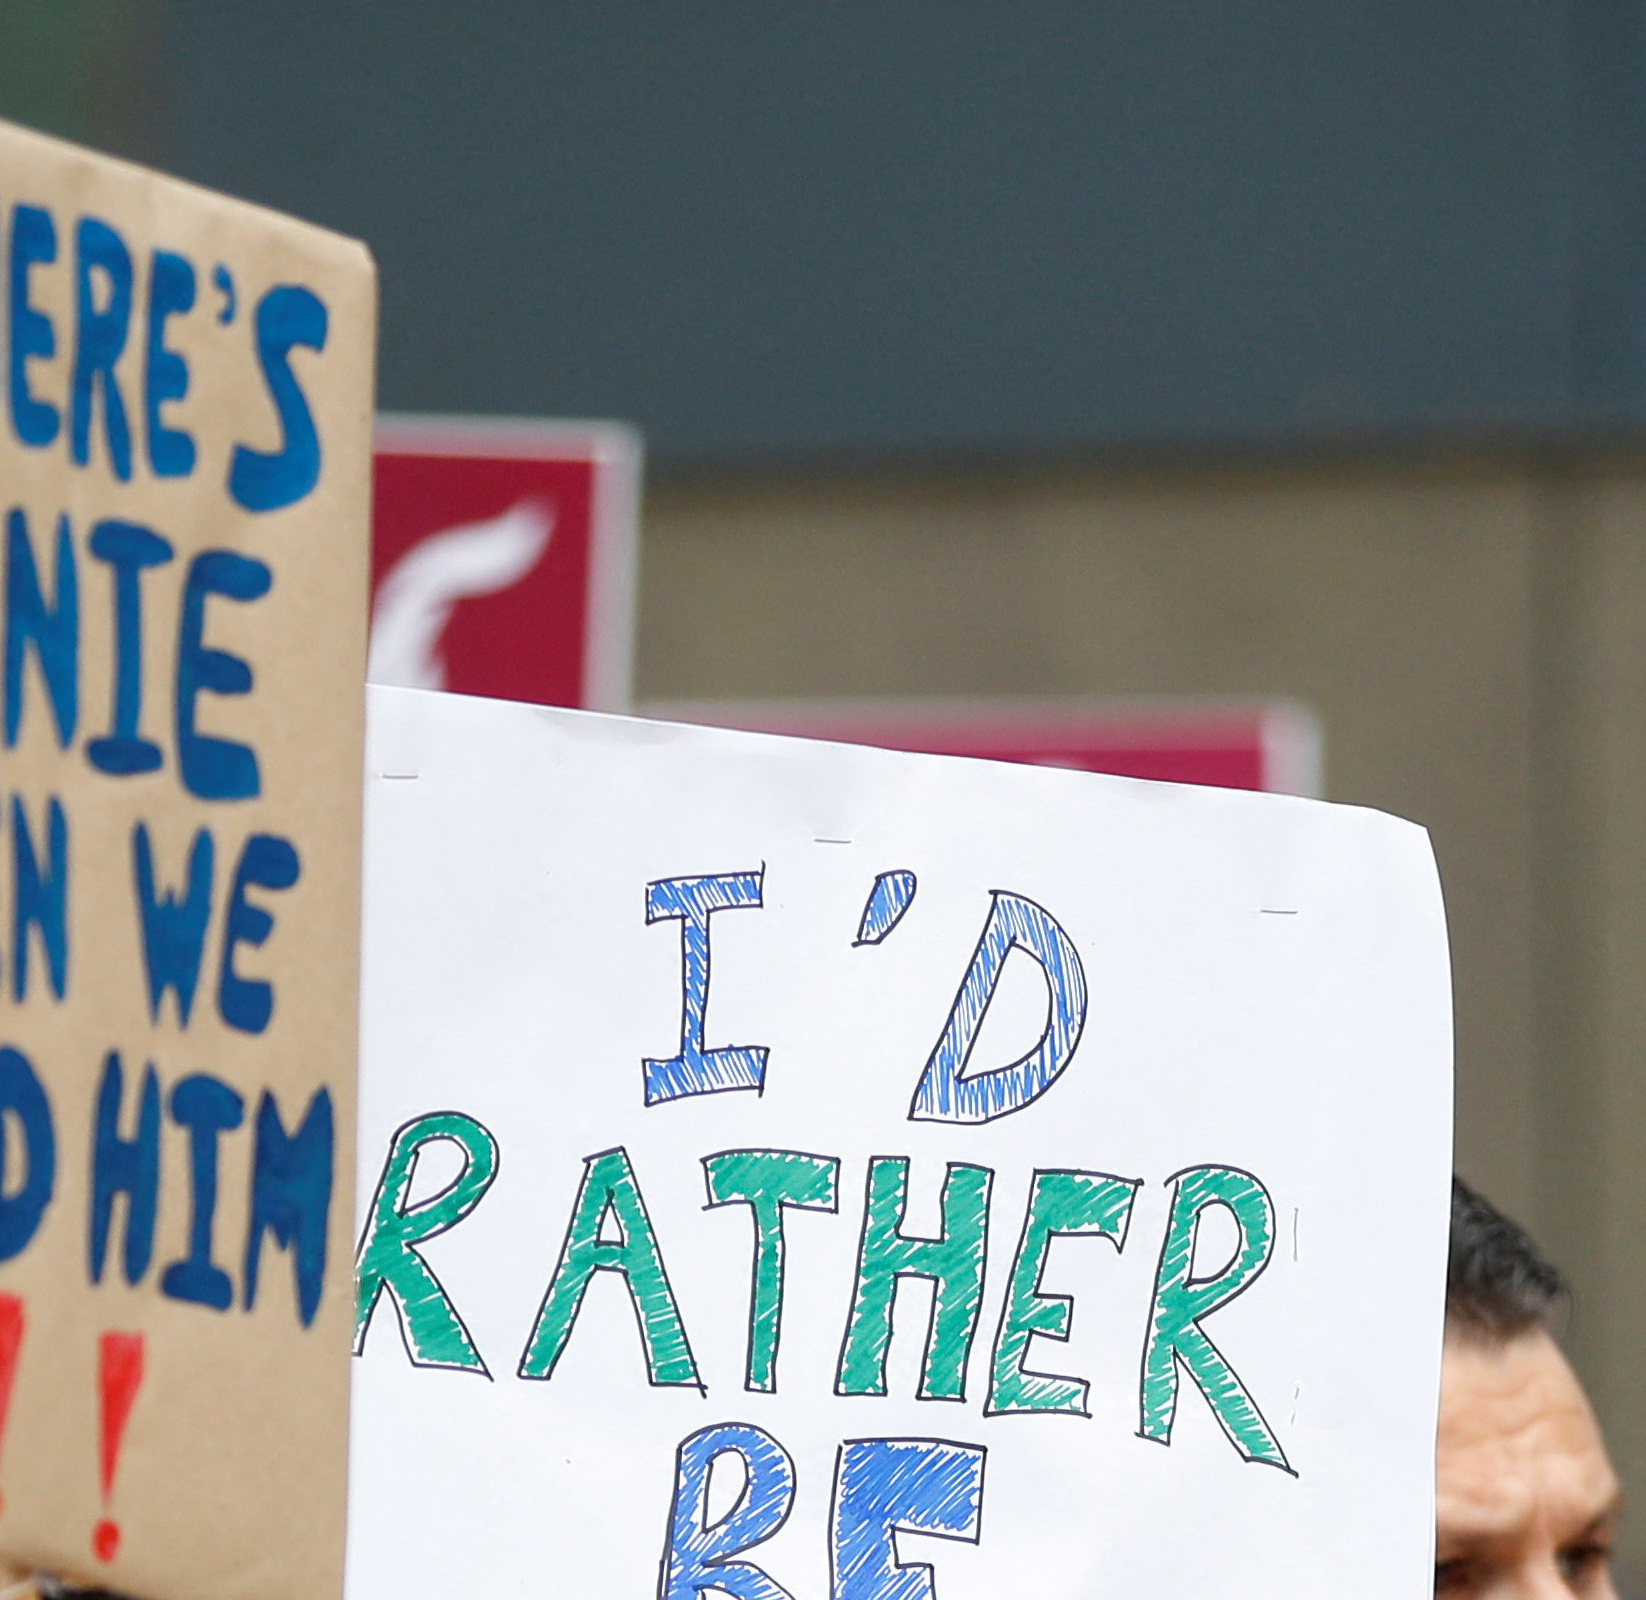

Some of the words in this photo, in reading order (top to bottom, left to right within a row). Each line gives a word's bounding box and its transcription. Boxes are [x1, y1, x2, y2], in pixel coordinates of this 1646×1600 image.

[133, 817, 302, 1036] WE
[641, 859, 1090, 1126] I'D
[89, 1046, 336, 1330] HIM
[353, 1109, 1301, 1480] RATHER
